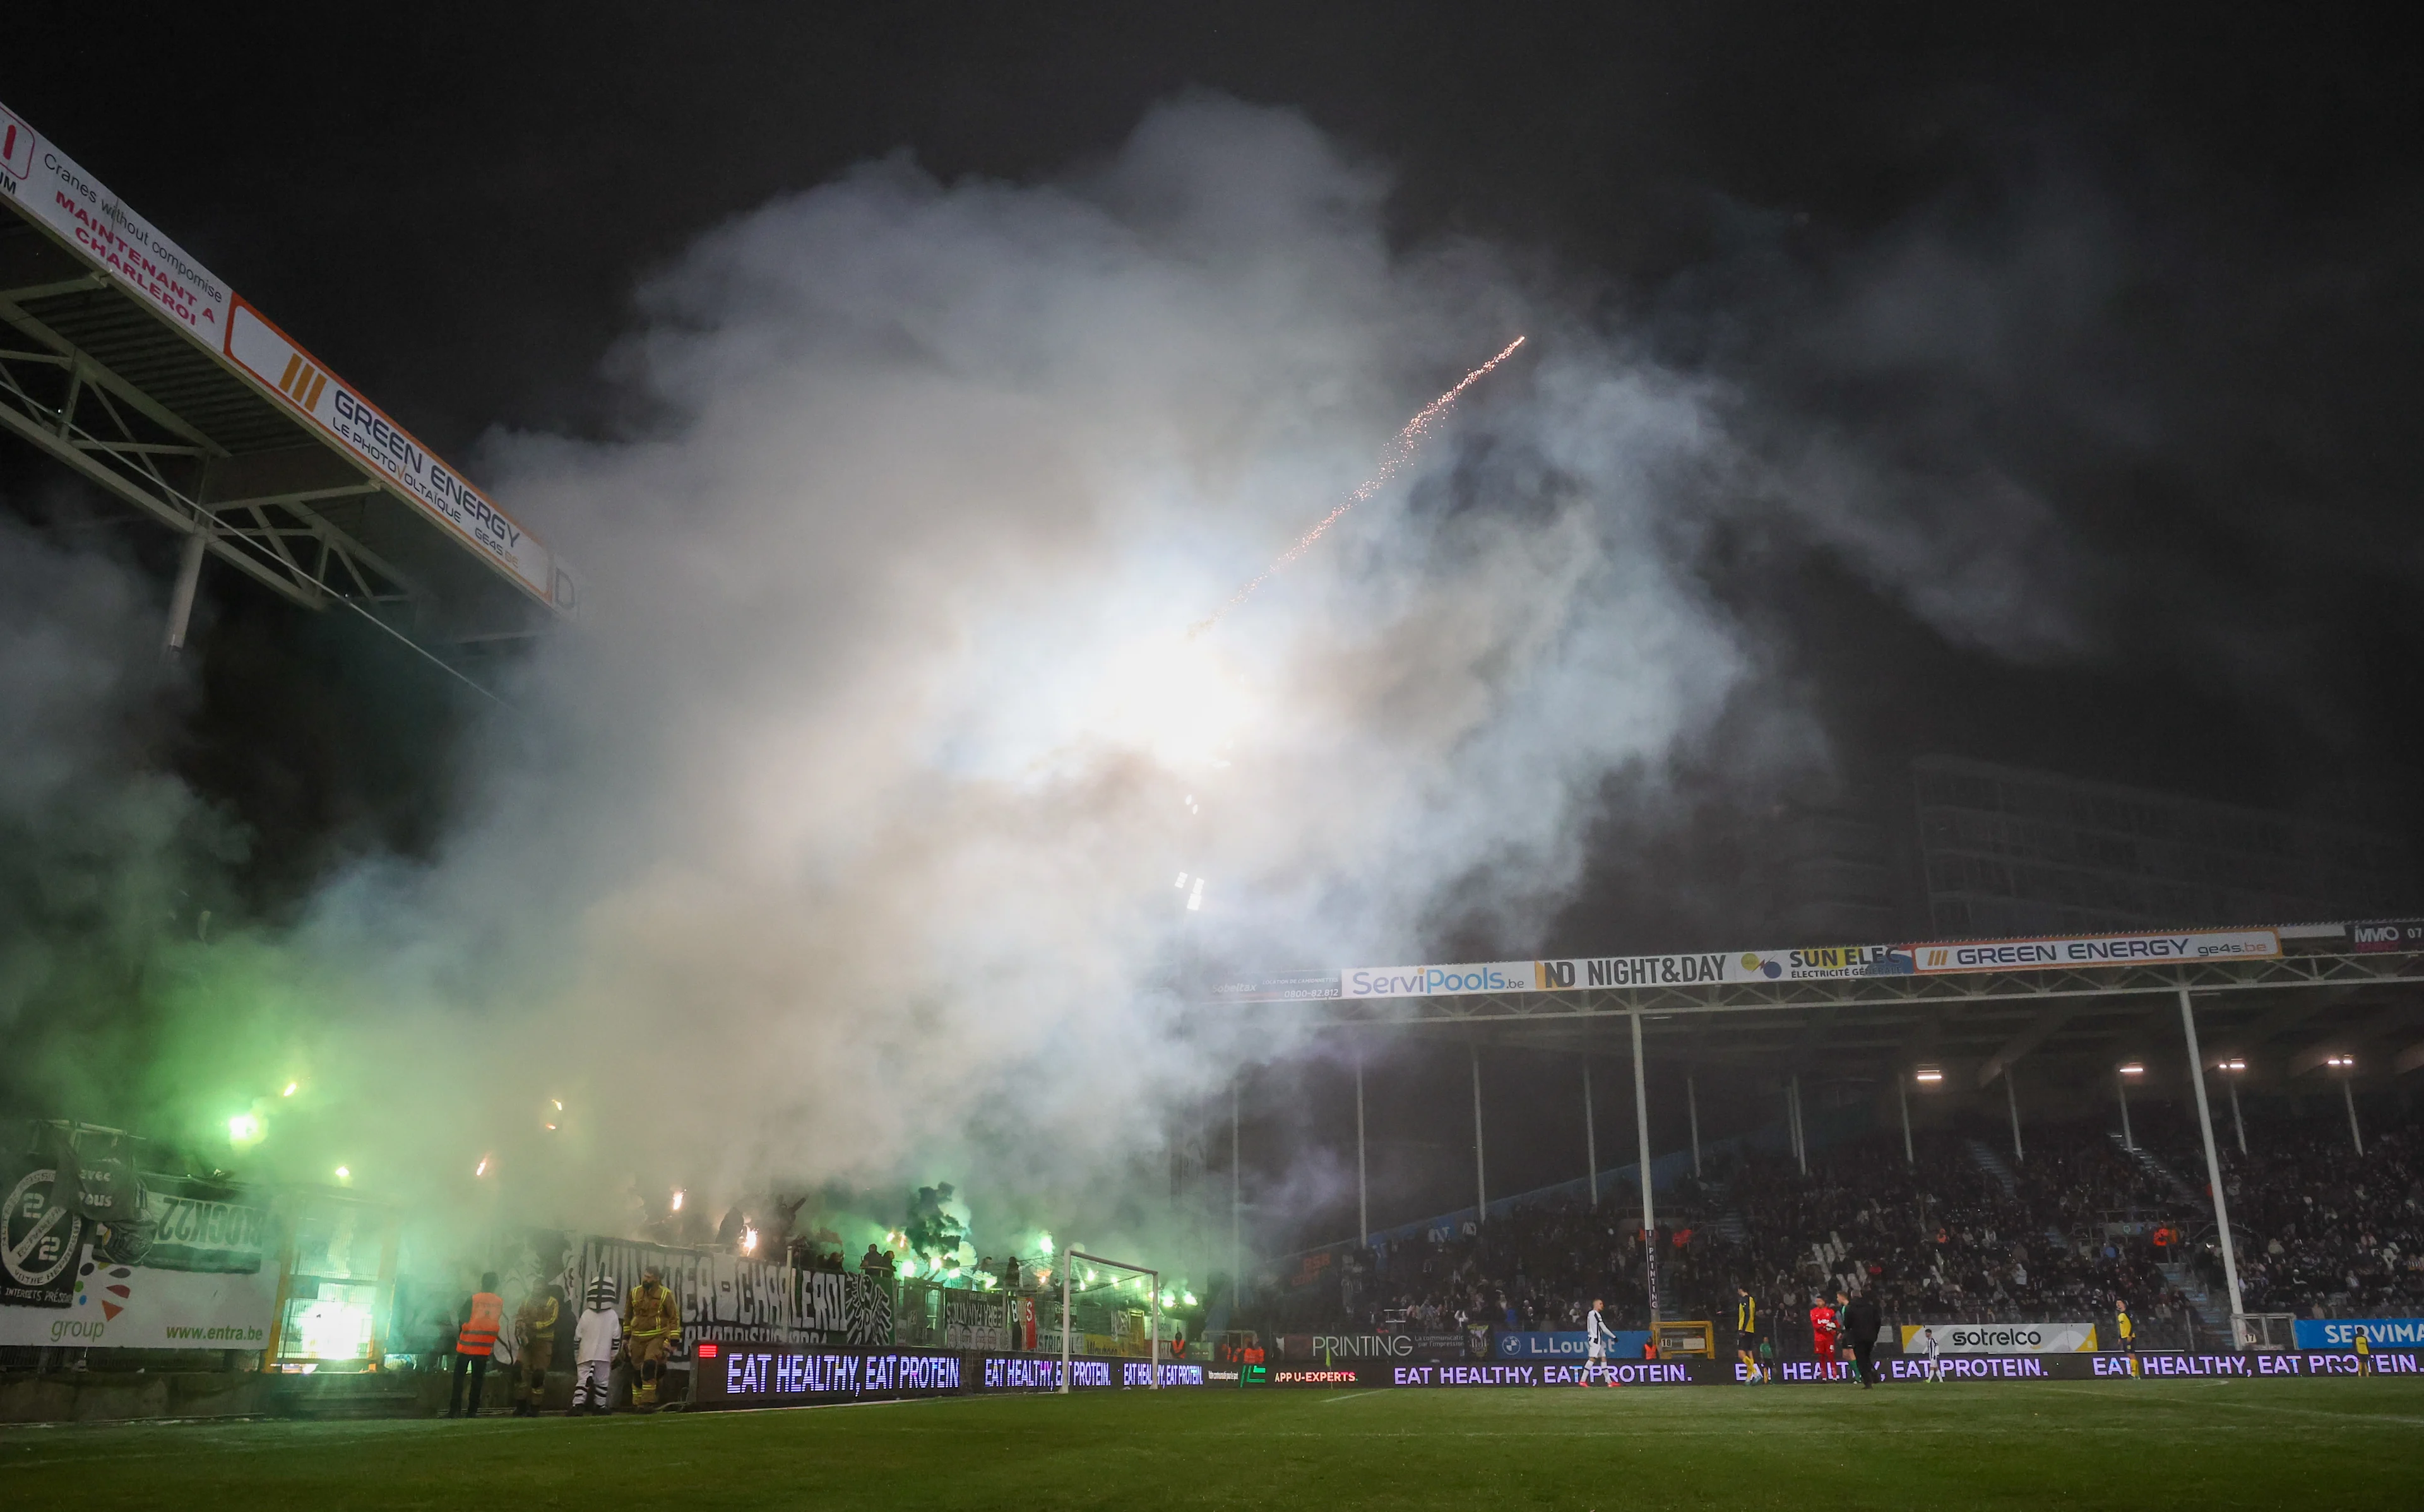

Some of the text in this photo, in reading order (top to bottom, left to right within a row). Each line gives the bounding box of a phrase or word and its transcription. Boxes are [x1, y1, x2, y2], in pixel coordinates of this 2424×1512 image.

[0, 172, 16, 195] M
[44, 153, 97, 203] Cranes
[102, 199, 150, 247] without
[56, 191, 215, 323] MAINTENANT A
[74, 227, 197, 326] CHARLEROI
[332, 416, 461, 524] LE PHOTOVOLTAÏQUE
[335, 389, 520, 548] GREEN ENERGY
[1789, 947, 1900, 968] SUN ELEC
[1957, 938, 2267, 966] GREEN ENERGY ge4s.be
[1352, 967, 1524, 995] ServiPools.be
[1587, 954, 1726, 986] NIGHT&DAY
[1791, 966, 1902, 978] ÉLECTRICITÉ GÉNÉRALE
[1284, 989, 1339, 998] 0800-82.812
[1648, 1247, 1660, 1309] PRINTING
[50, 1321, 105, 1343] group
[166, 1325, 263, 1341] www.entra.be
[1952, 1328, 2041, 1346] sotrelco
[1312, 1335, 1413, 1357] PRINTING
[1531, 1337, 1615, 1354] L.Louvt
[727, 1353, 773, 1393] EAT
[776, 1354, 861, 1397] HEALTHY,
[865, 1354, 897, 1390] EAT
[985, 1359, 1006, 1387] EAT
[1007, 1359, 1054, 1391] HEALTHY,
[1073, 1361, 1111, 1386] PROTEIN.
[1124, 1363, 1137, 1386] EAT
[1138, 1363, 1165, 1390] HEALHY,
[1166, 1365, 1179, 1386] EAT
[1274, 1372, 1293, 1383] APP
[1394, 1364, 1692, 1387] EAT HEALTHY, EAT PROTEIN.
[1735, 1358, 2049, 1382] EA HEALT, EAT PROTEIN.
[2093, 1354, 2424, 1377] EAT HEALTHY, EAT PROEIN.
